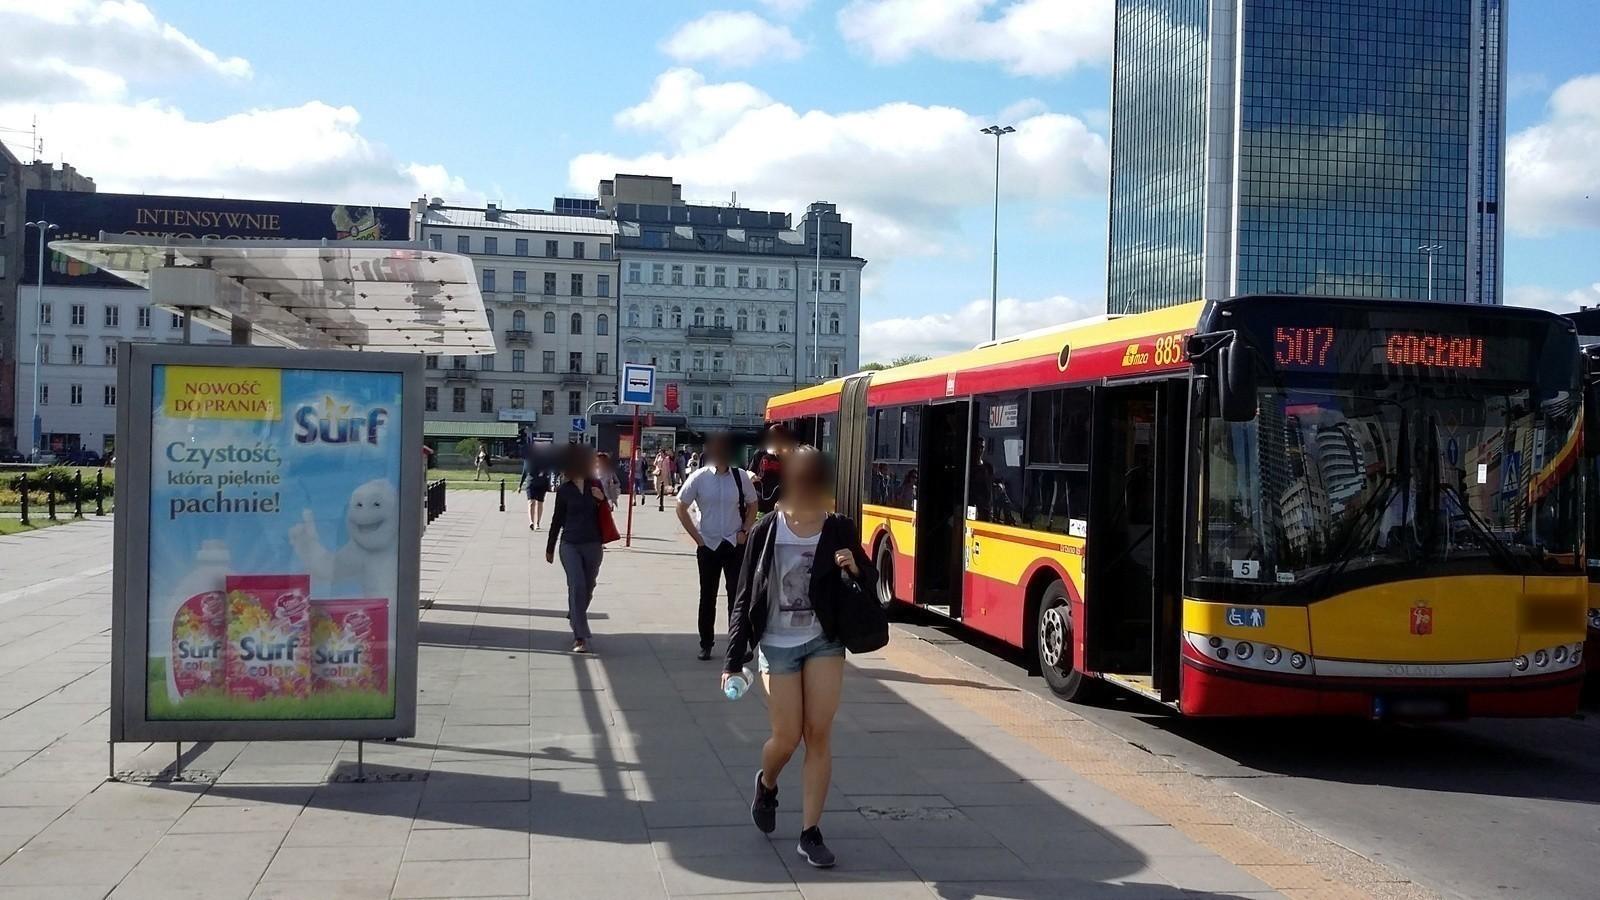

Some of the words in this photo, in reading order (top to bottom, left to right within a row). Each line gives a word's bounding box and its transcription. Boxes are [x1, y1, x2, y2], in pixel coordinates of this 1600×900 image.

[136, 208, 281, 231] INTENSYWNIE
[1154, 334, 1185, 366] 885
[1276, 327, 1334, 366] 507
[1387, 335, 1483, 368] GOCŁAW
[185, 380, 261, 396] NOWOŚĆ
[175, 400, 201, 412] DO
[295, 406, 388, 445] Surf
[166, 441, 282, 470] Czystość,
[167, 470, 213, 486] która
[217, 470, 281, 490] pięknie
[170, 490, 280, 520] pachnie!
[1241, 562, 1250, 576] 5
[178, 641, 222, 659] Surf
[240, 636, 300, 661] Surf
[315, 644, 364, 664] Surf
[247, 663, 293, 677] color
